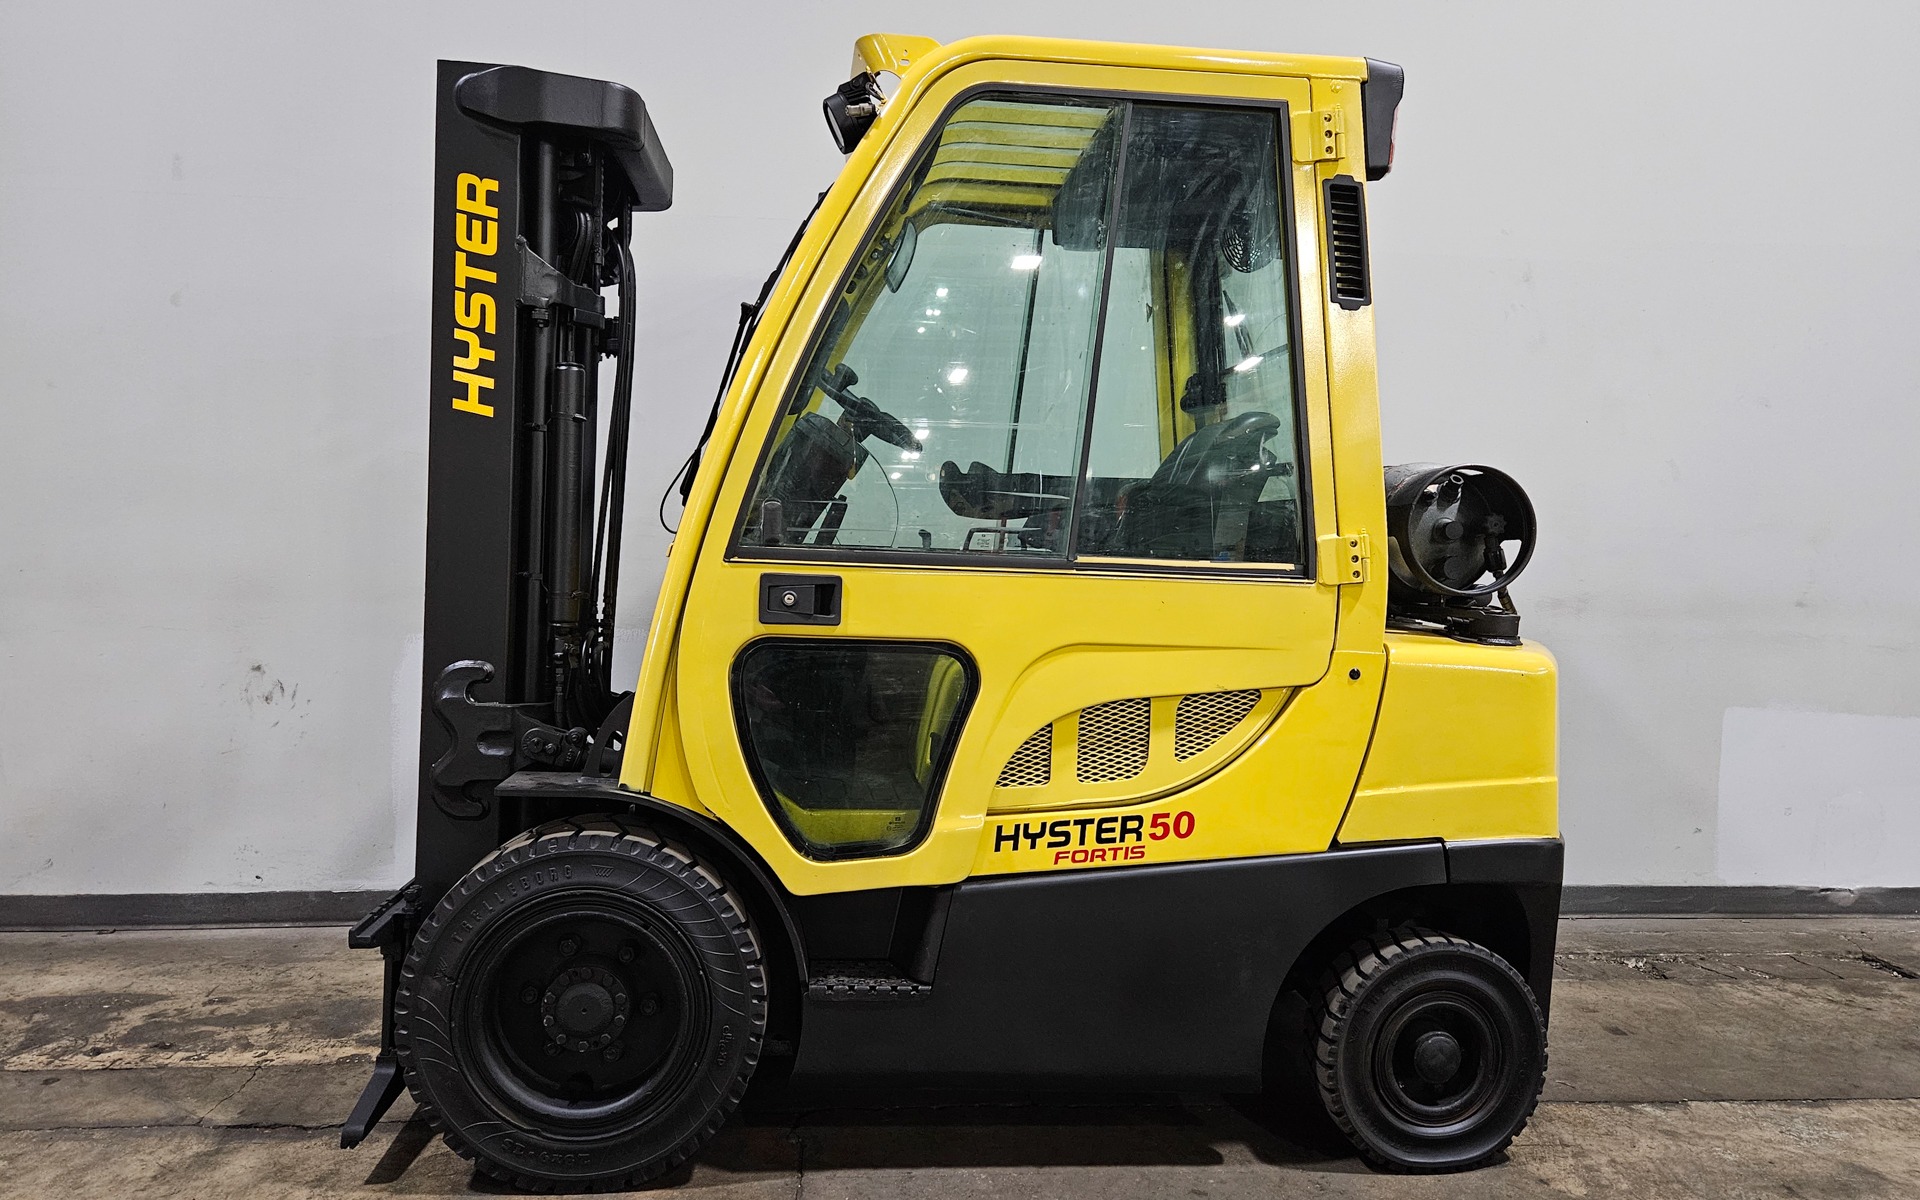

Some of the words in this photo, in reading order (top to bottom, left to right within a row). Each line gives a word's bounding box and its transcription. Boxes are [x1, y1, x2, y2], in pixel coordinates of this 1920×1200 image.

[452, 172, 499, 418] HYSTER
[994, 815, 1144, 852] HYSTER
[1149, 811, 1196, 841] 50
[1053, 845, 1146, 865] FORTIS
[451, 864, 572, 942] TRELLEBORG
